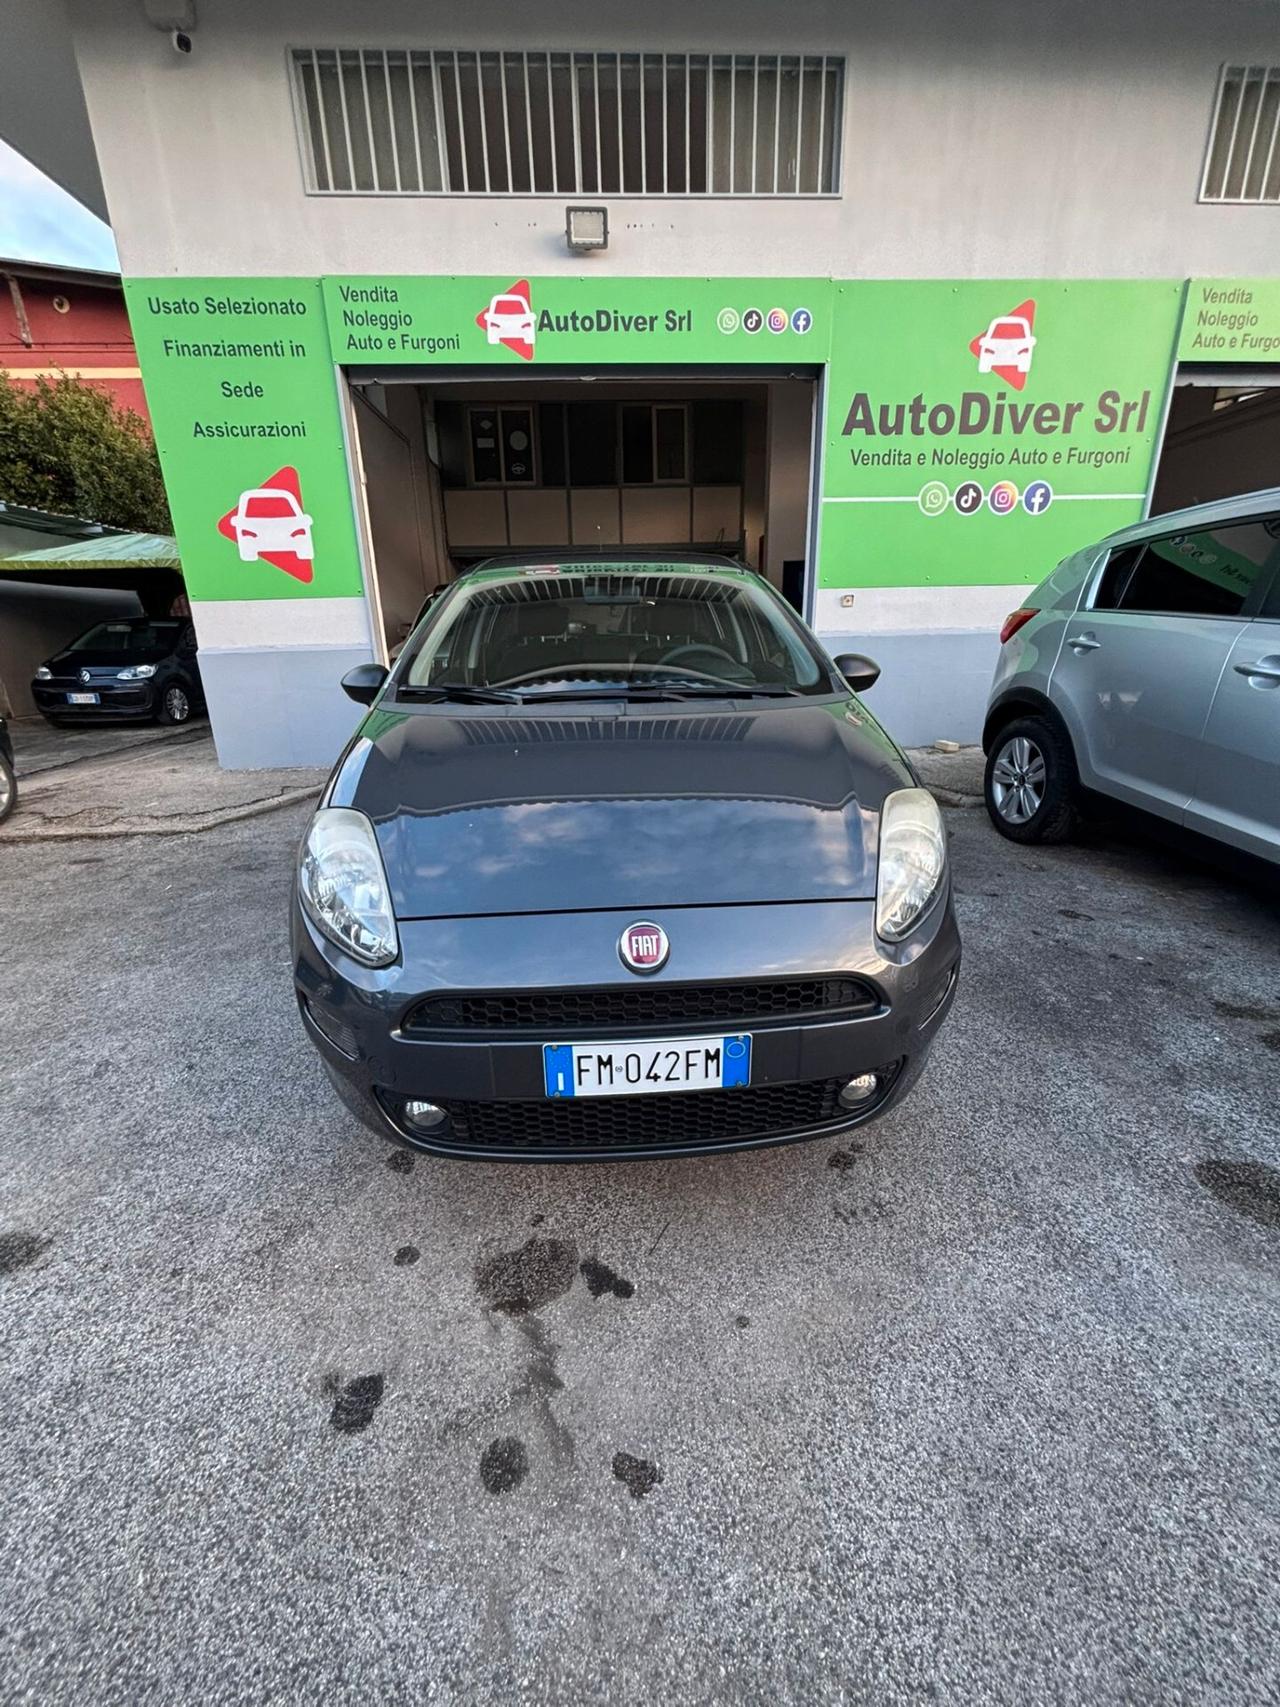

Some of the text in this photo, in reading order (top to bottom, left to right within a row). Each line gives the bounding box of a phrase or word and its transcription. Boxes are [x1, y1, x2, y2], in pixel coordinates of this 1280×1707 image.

[339, 286, 398, 303] Vendita
[1203, 288, 1253, 304] Vendita
[148, 297, 307, 315] Usato Selezionato
[343, 310, 412, 330] Noleggio
[538, 309, 692, 332] AutoDiver Srl
[1197, 310, 1258, 330] Noleggio
[163, 339, 305, 357] Finanziamenti in
[347, 334, 460, 354] Auto e Furgoni
[1192, 332, 1225, 348] Auto
[1229, 336, 1238, 348] e
[221, 381, 263, 398] Sede
[841, 390, 1150, 436] AutoDiver Srl
[193, 421, 306, 438] Assicurazioni
[851, 446, 1130, 469] Vendita e Noleggio Auto e Furgoni
[632, 935, 659, 956] FIAT
